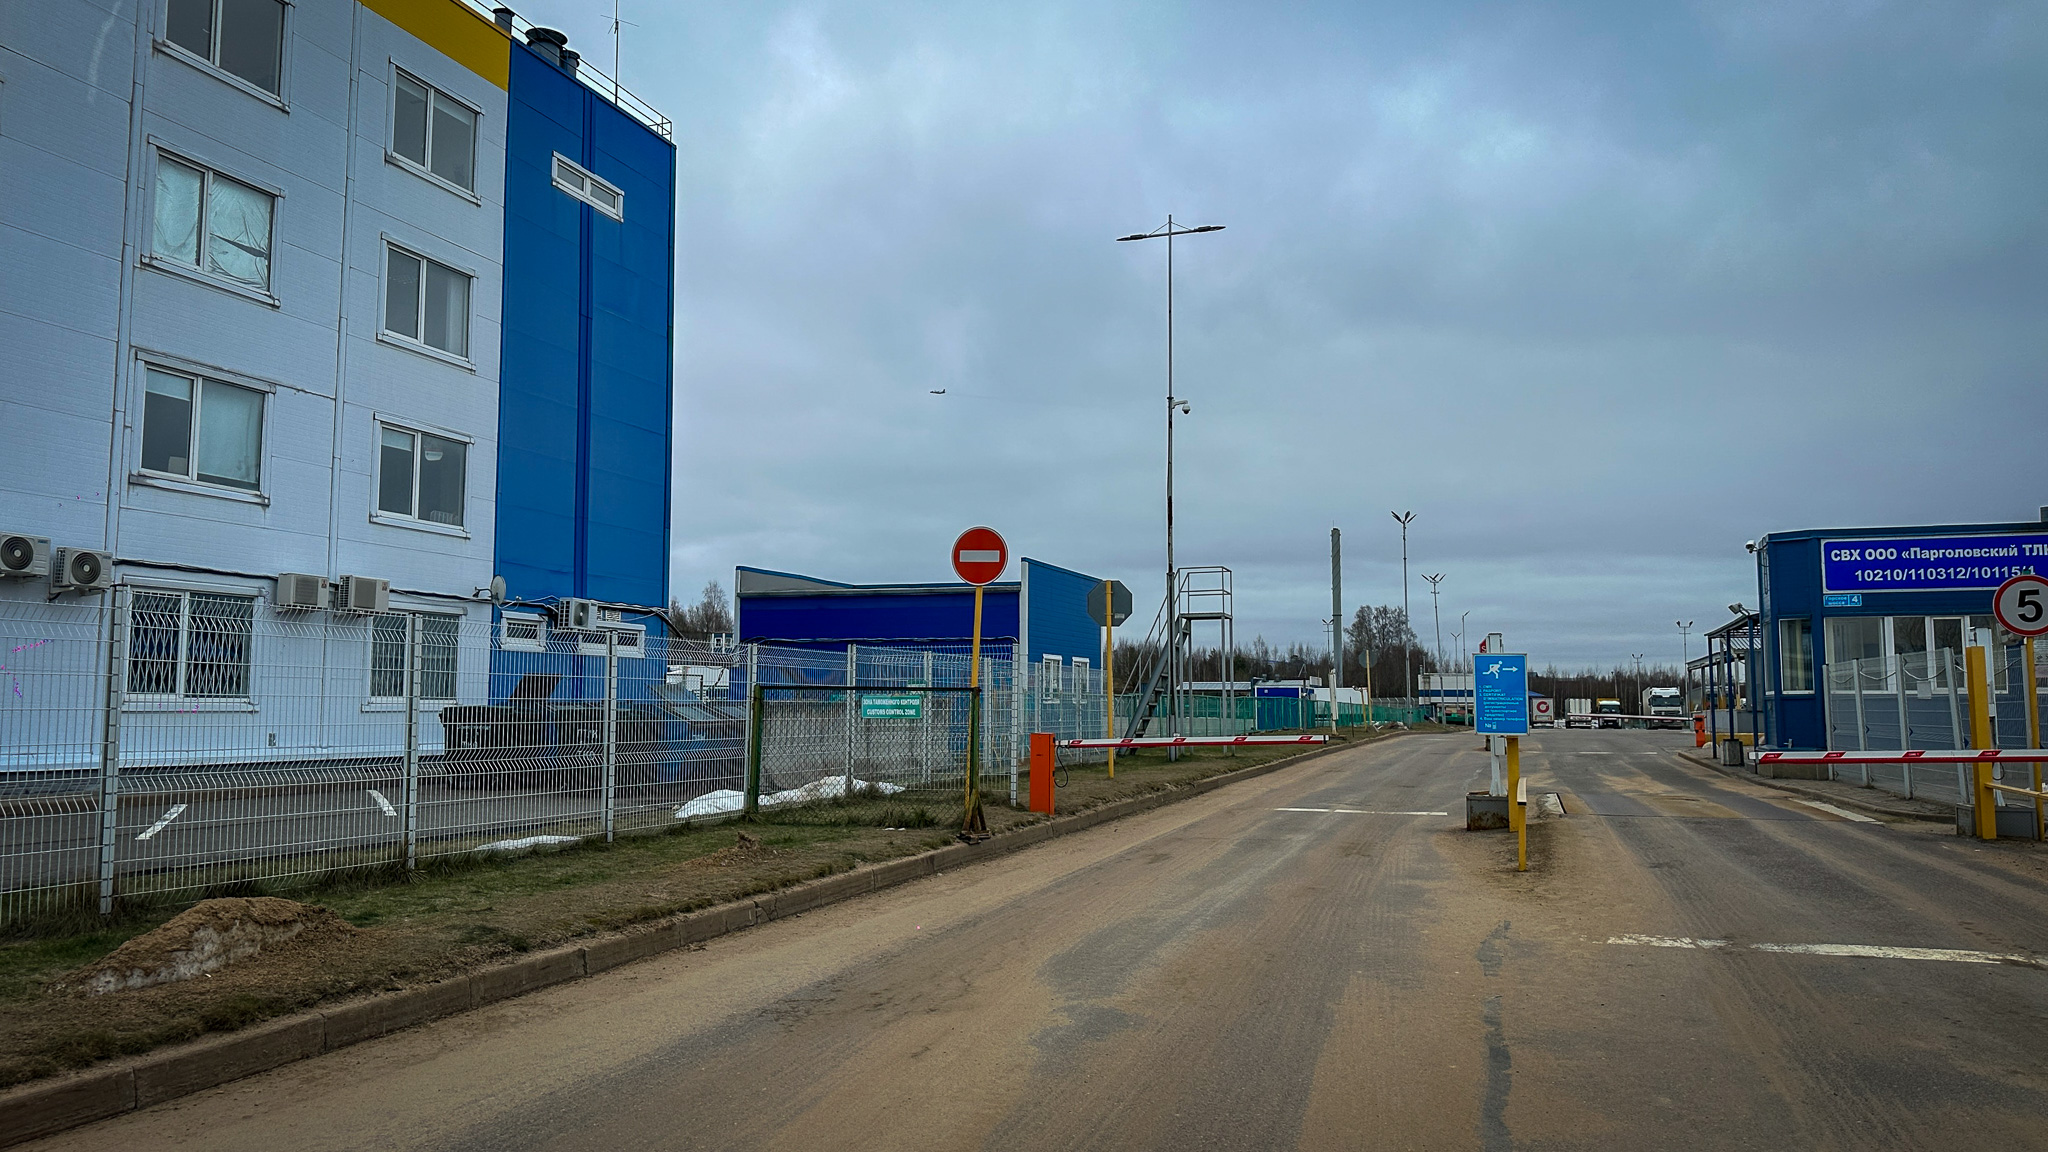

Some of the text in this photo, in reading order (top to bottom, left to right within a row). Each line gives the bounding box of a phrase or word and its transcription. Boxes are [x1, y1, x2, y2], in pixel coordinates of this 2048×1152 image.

[1831, 549, 1861, 562] СВХ
[1865, 548, 1897, 560] ООО
[1902, 544, 2018, 562] «Парголовский
[2017, 589, 2044, 623] 5
